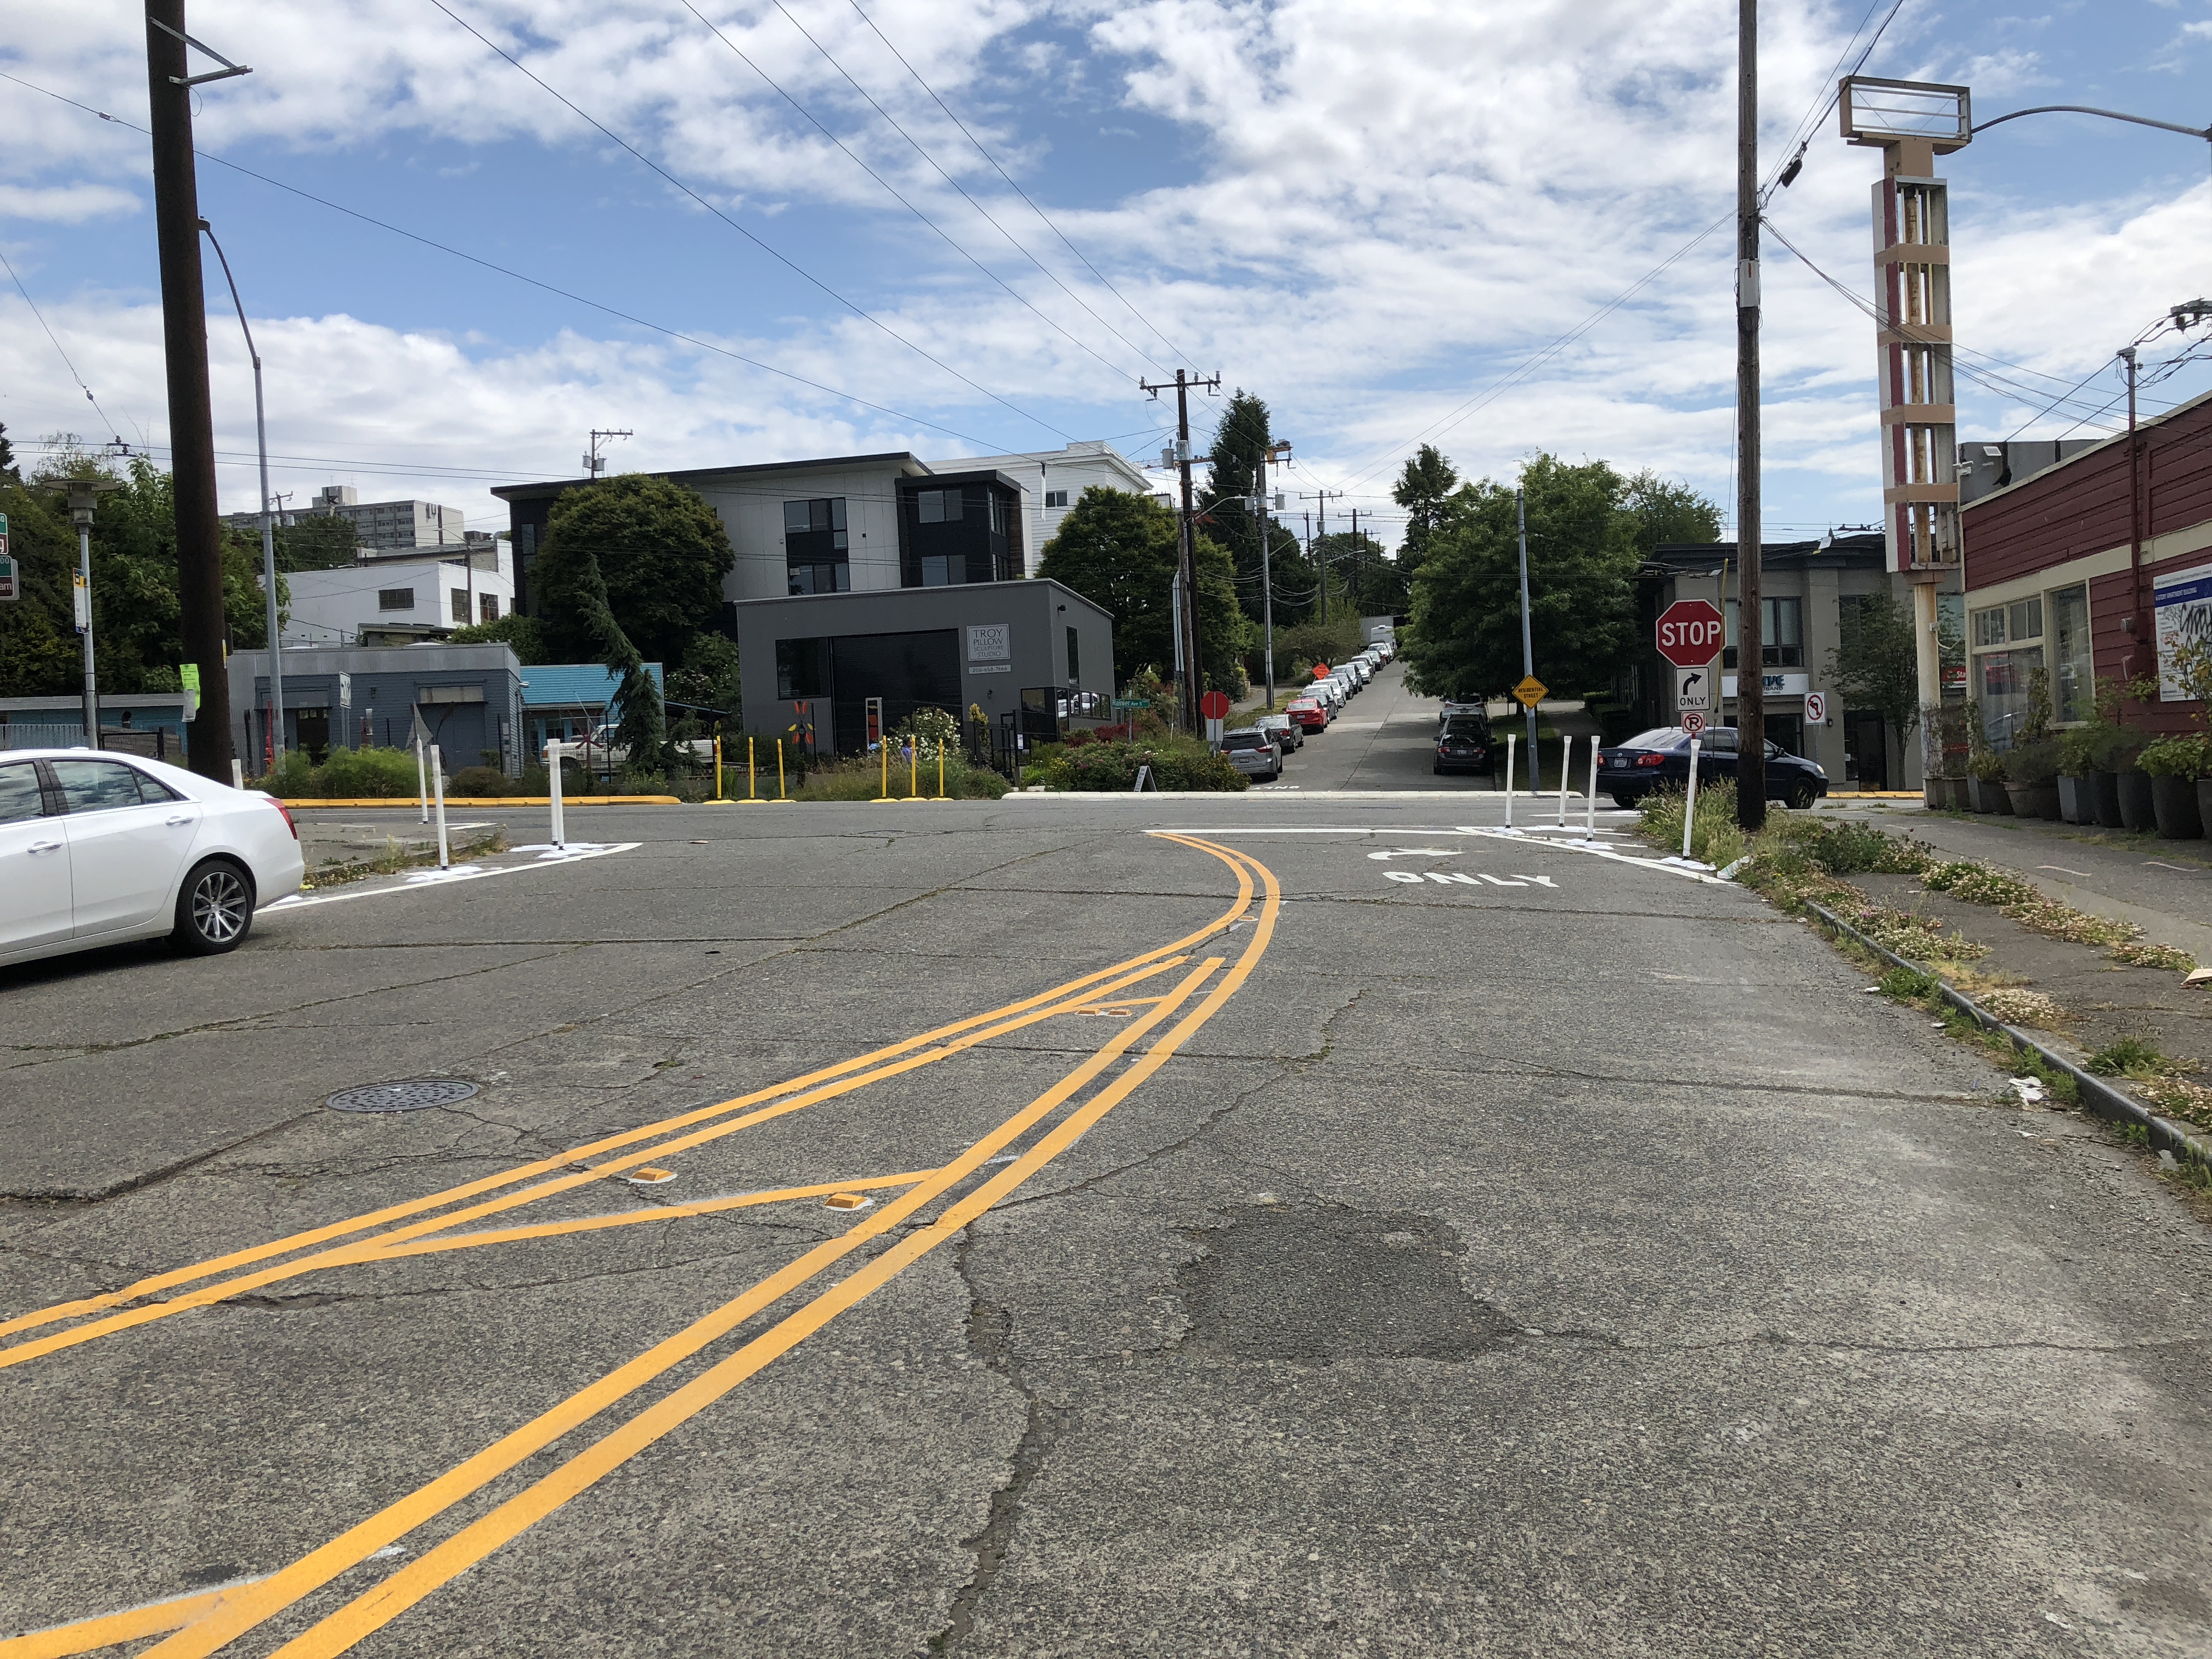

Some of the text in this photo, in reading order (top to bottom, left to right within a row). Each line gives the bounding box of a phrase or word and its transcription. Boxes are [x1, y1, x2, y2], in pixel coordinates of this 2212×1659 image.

[973, 629, 1003, 638] TROY
[1661, 620, 1721, 646] STOP
[973, 637, 1003, 646] PILLOW
[1680, 697, 1706, 706] ONLY
[1382, 871, 1560, 888] ONLY
